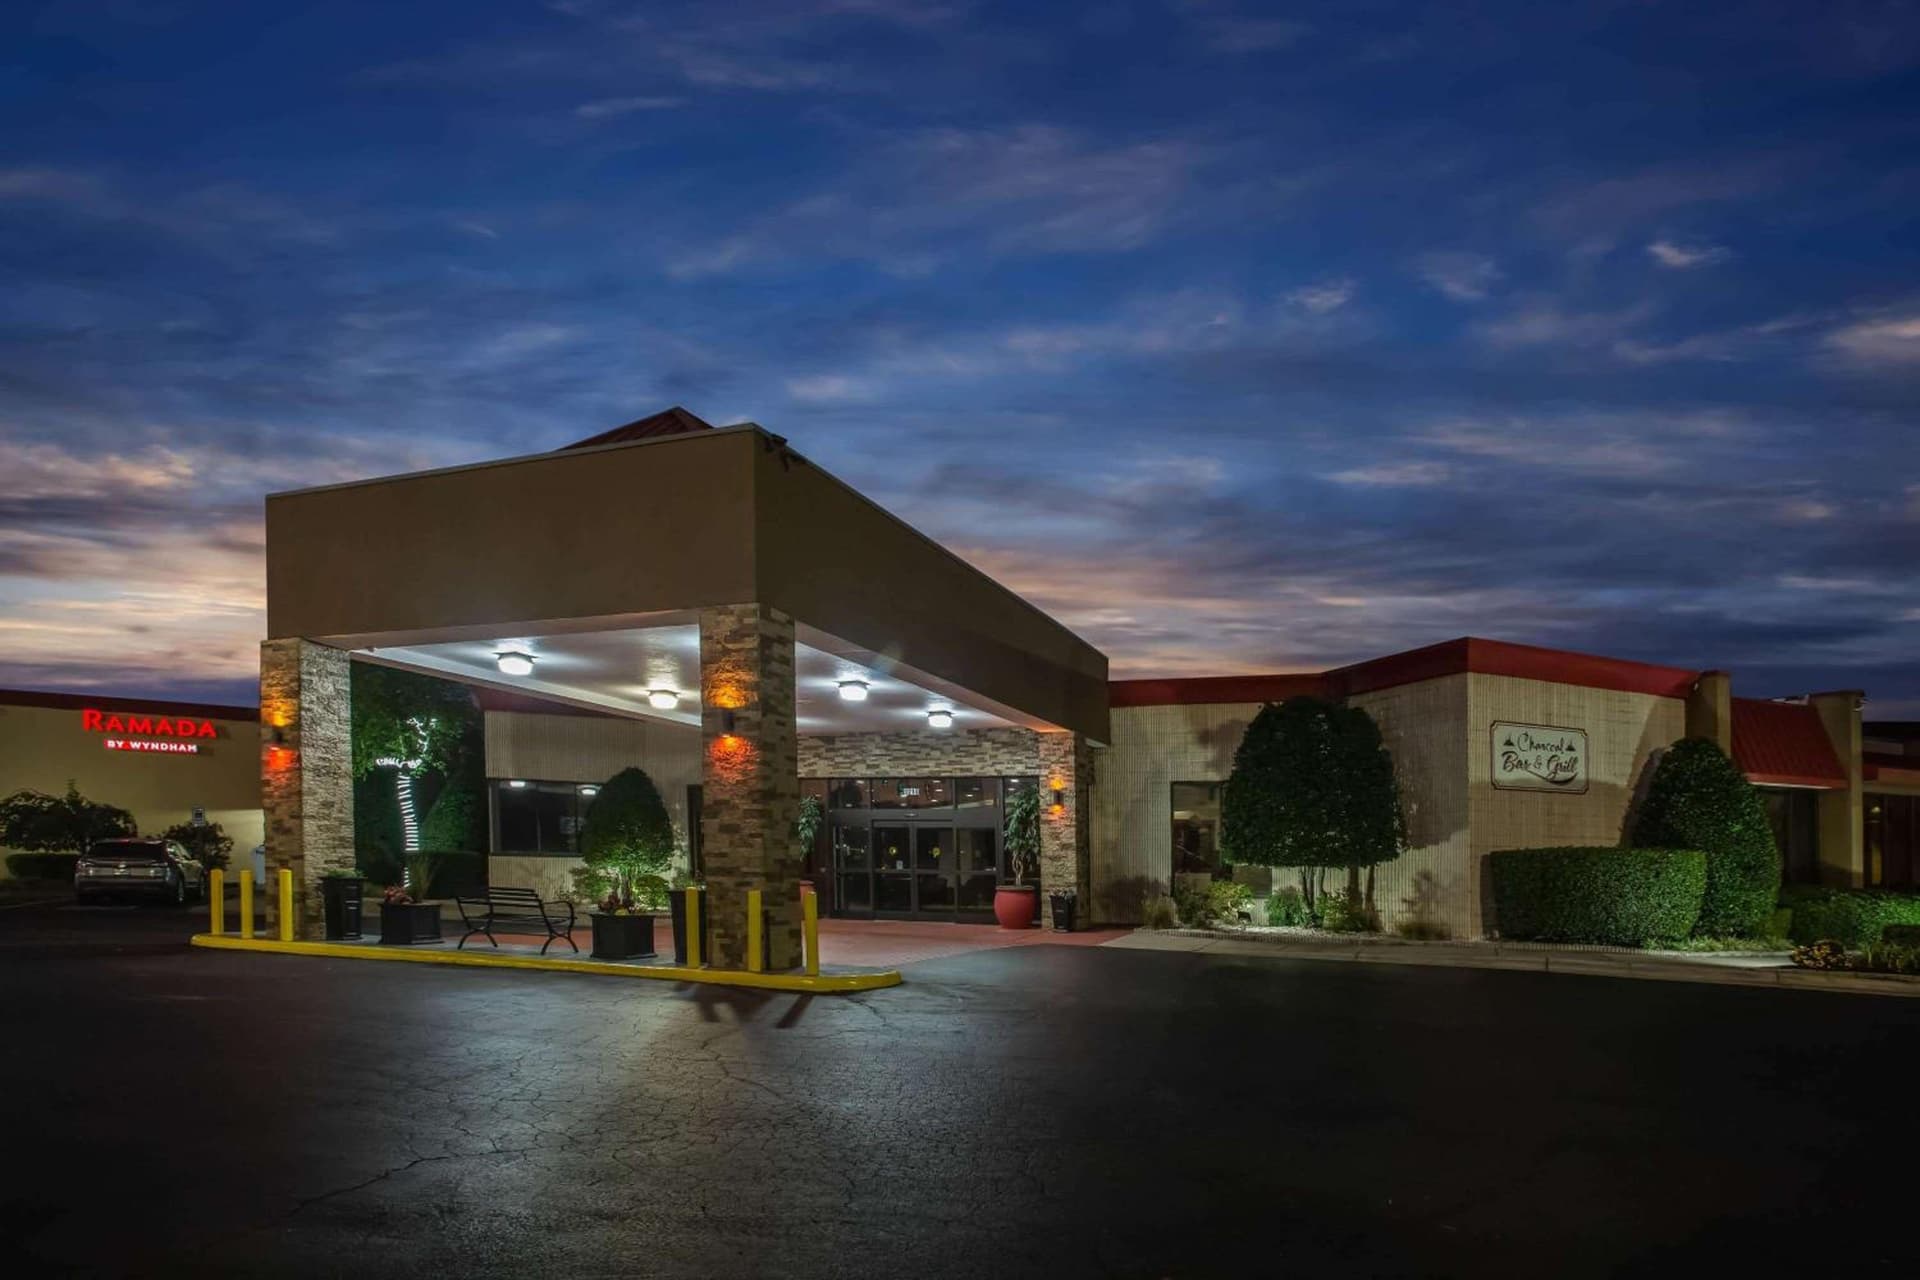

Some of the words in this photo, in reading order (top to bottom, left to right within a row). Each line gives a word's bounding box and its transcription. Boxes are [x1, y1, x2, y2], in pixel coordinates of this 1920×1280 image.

[82, 708, 217, 738] RAMADA
[107, 739, 124, 749] BY
[129, 741, 198, 753] WYNDHAM
[1517, 731, 1565, 754] Charcoal
[1501, 751, 1531, 773] Bar
[1533, 755, 1542, 769] &
[1546, 754, 1578, 781] Grill
